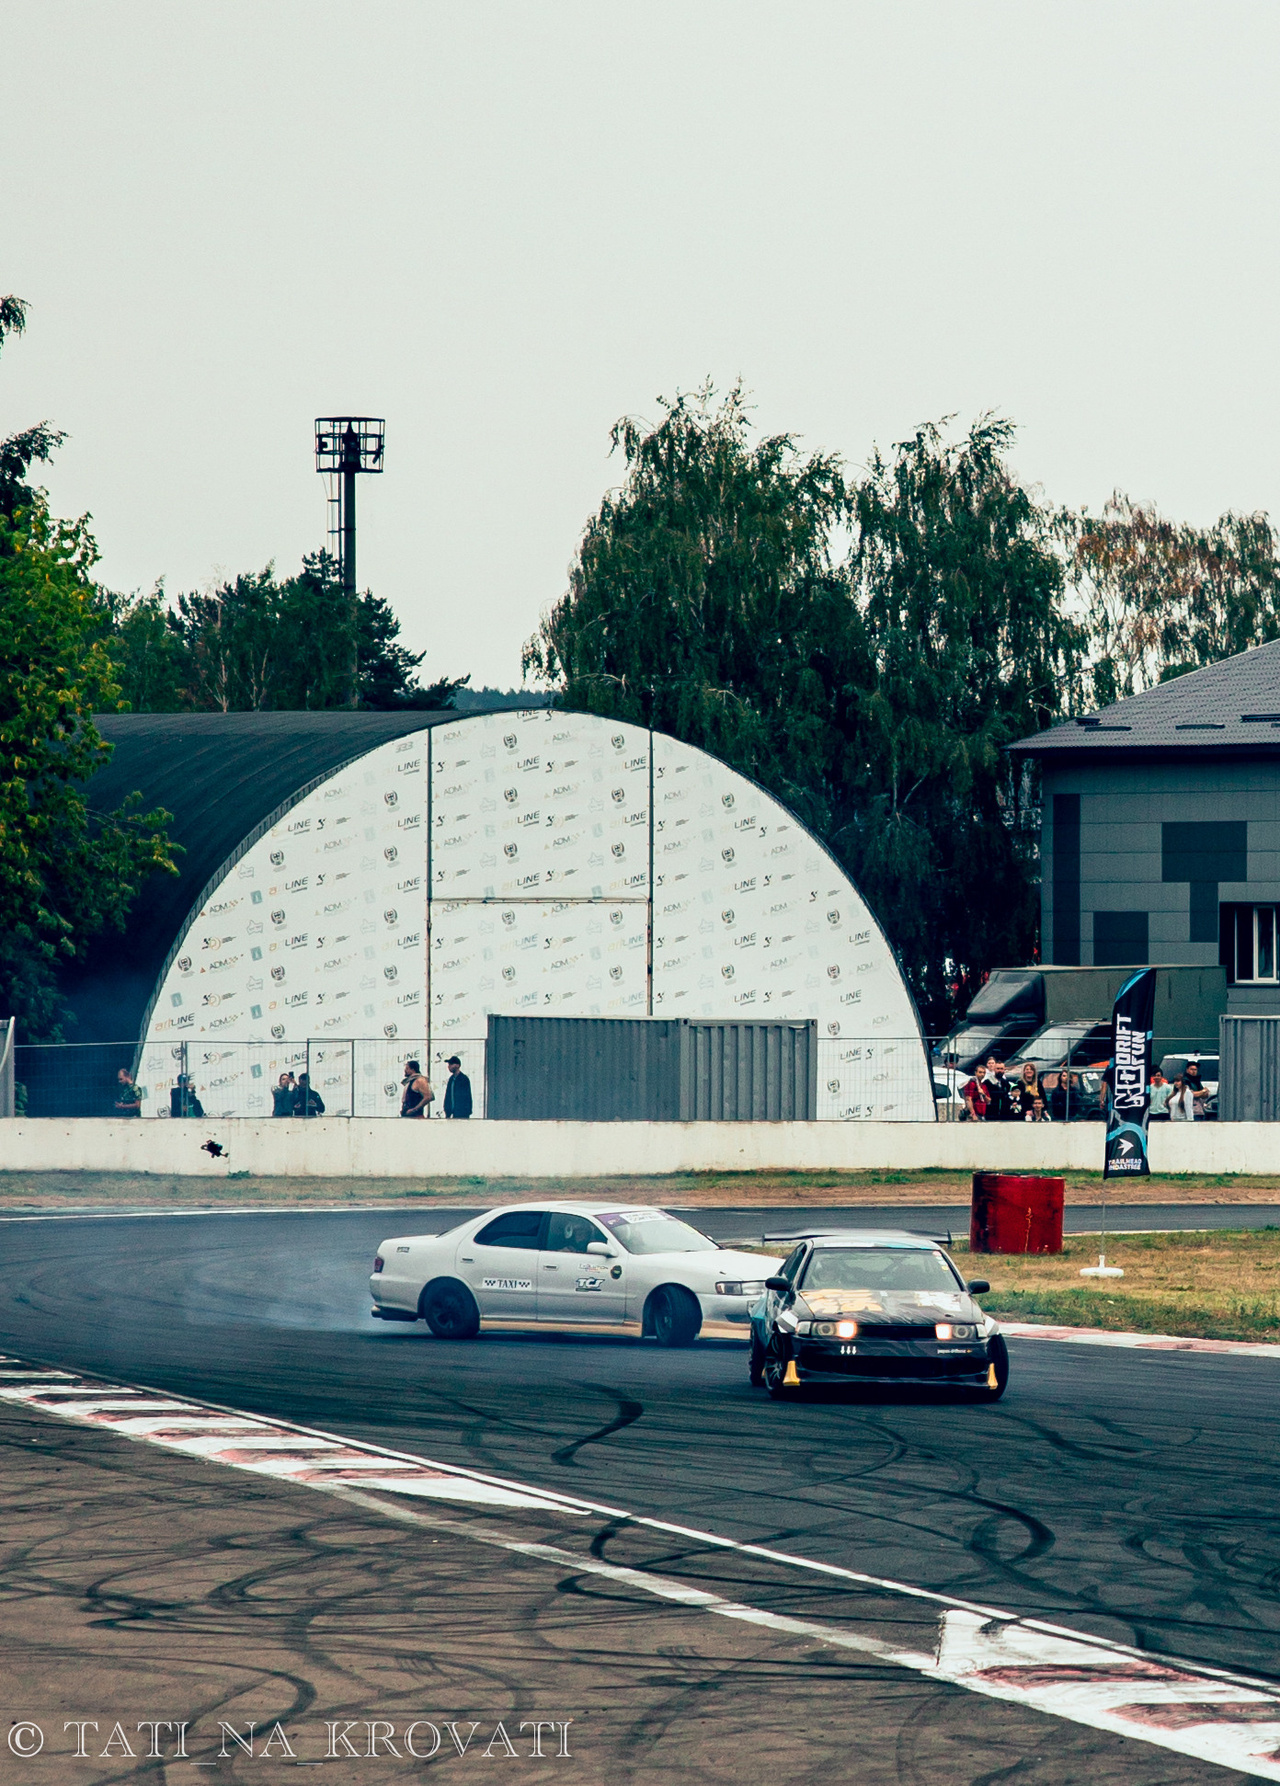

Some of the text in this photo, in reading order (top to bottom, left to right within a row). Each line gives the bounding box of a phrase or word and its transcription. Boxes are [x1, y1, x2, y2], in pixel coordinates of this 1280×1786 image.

[1116, 1013, 1131, 1065] DRIFT
[1131, 1031, 1146, 1065] FUN
[497, 1280, 517, 1288] TAXI
